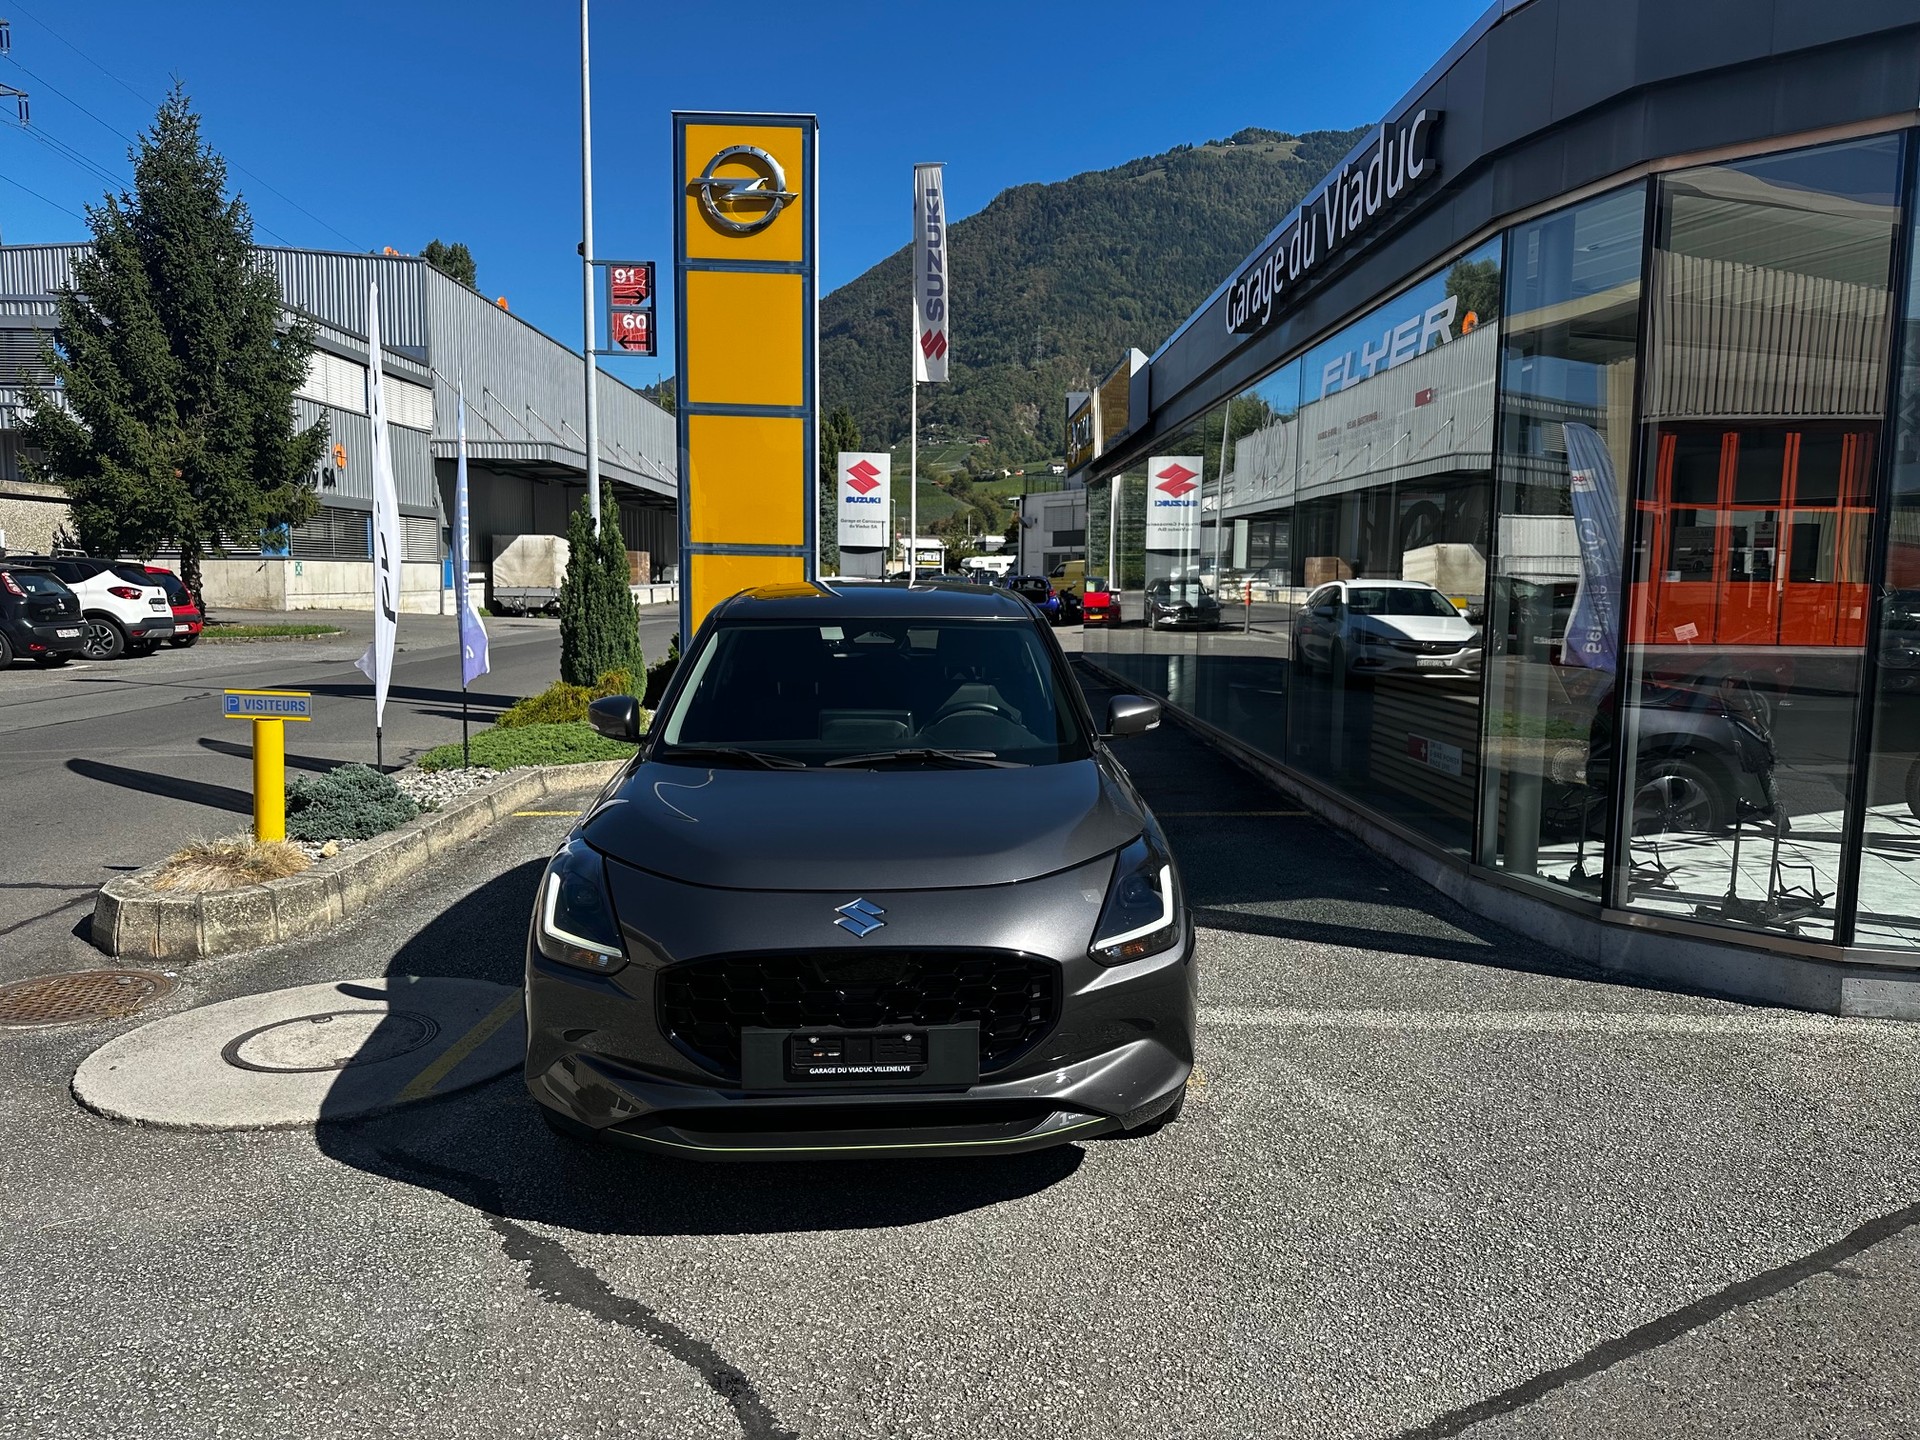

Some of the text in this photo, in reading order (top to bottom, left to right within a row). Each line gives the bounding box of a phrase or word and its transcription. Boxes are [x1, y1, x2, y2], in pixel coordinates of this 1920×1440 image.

[717, 145, 769, 160] OPEL
[1225, 109, 1426, 335] Garage du Viaduc
[926, 188, 945, 322] SUZUKI
[614, 268, 635, 284] 91
[622, 313, 647, 330] 60
[1319, 294, 1458, 401] FLYER
[845, 496, 881, 504] SUZUKI
[244, 698, 306, 712] VISITEURS
[809, 1067, 836, 1075] GARAGE
[848, 1066, 873, 1074] VIADUC
[873, 1065, 911, 1073] VILLENEUVE
